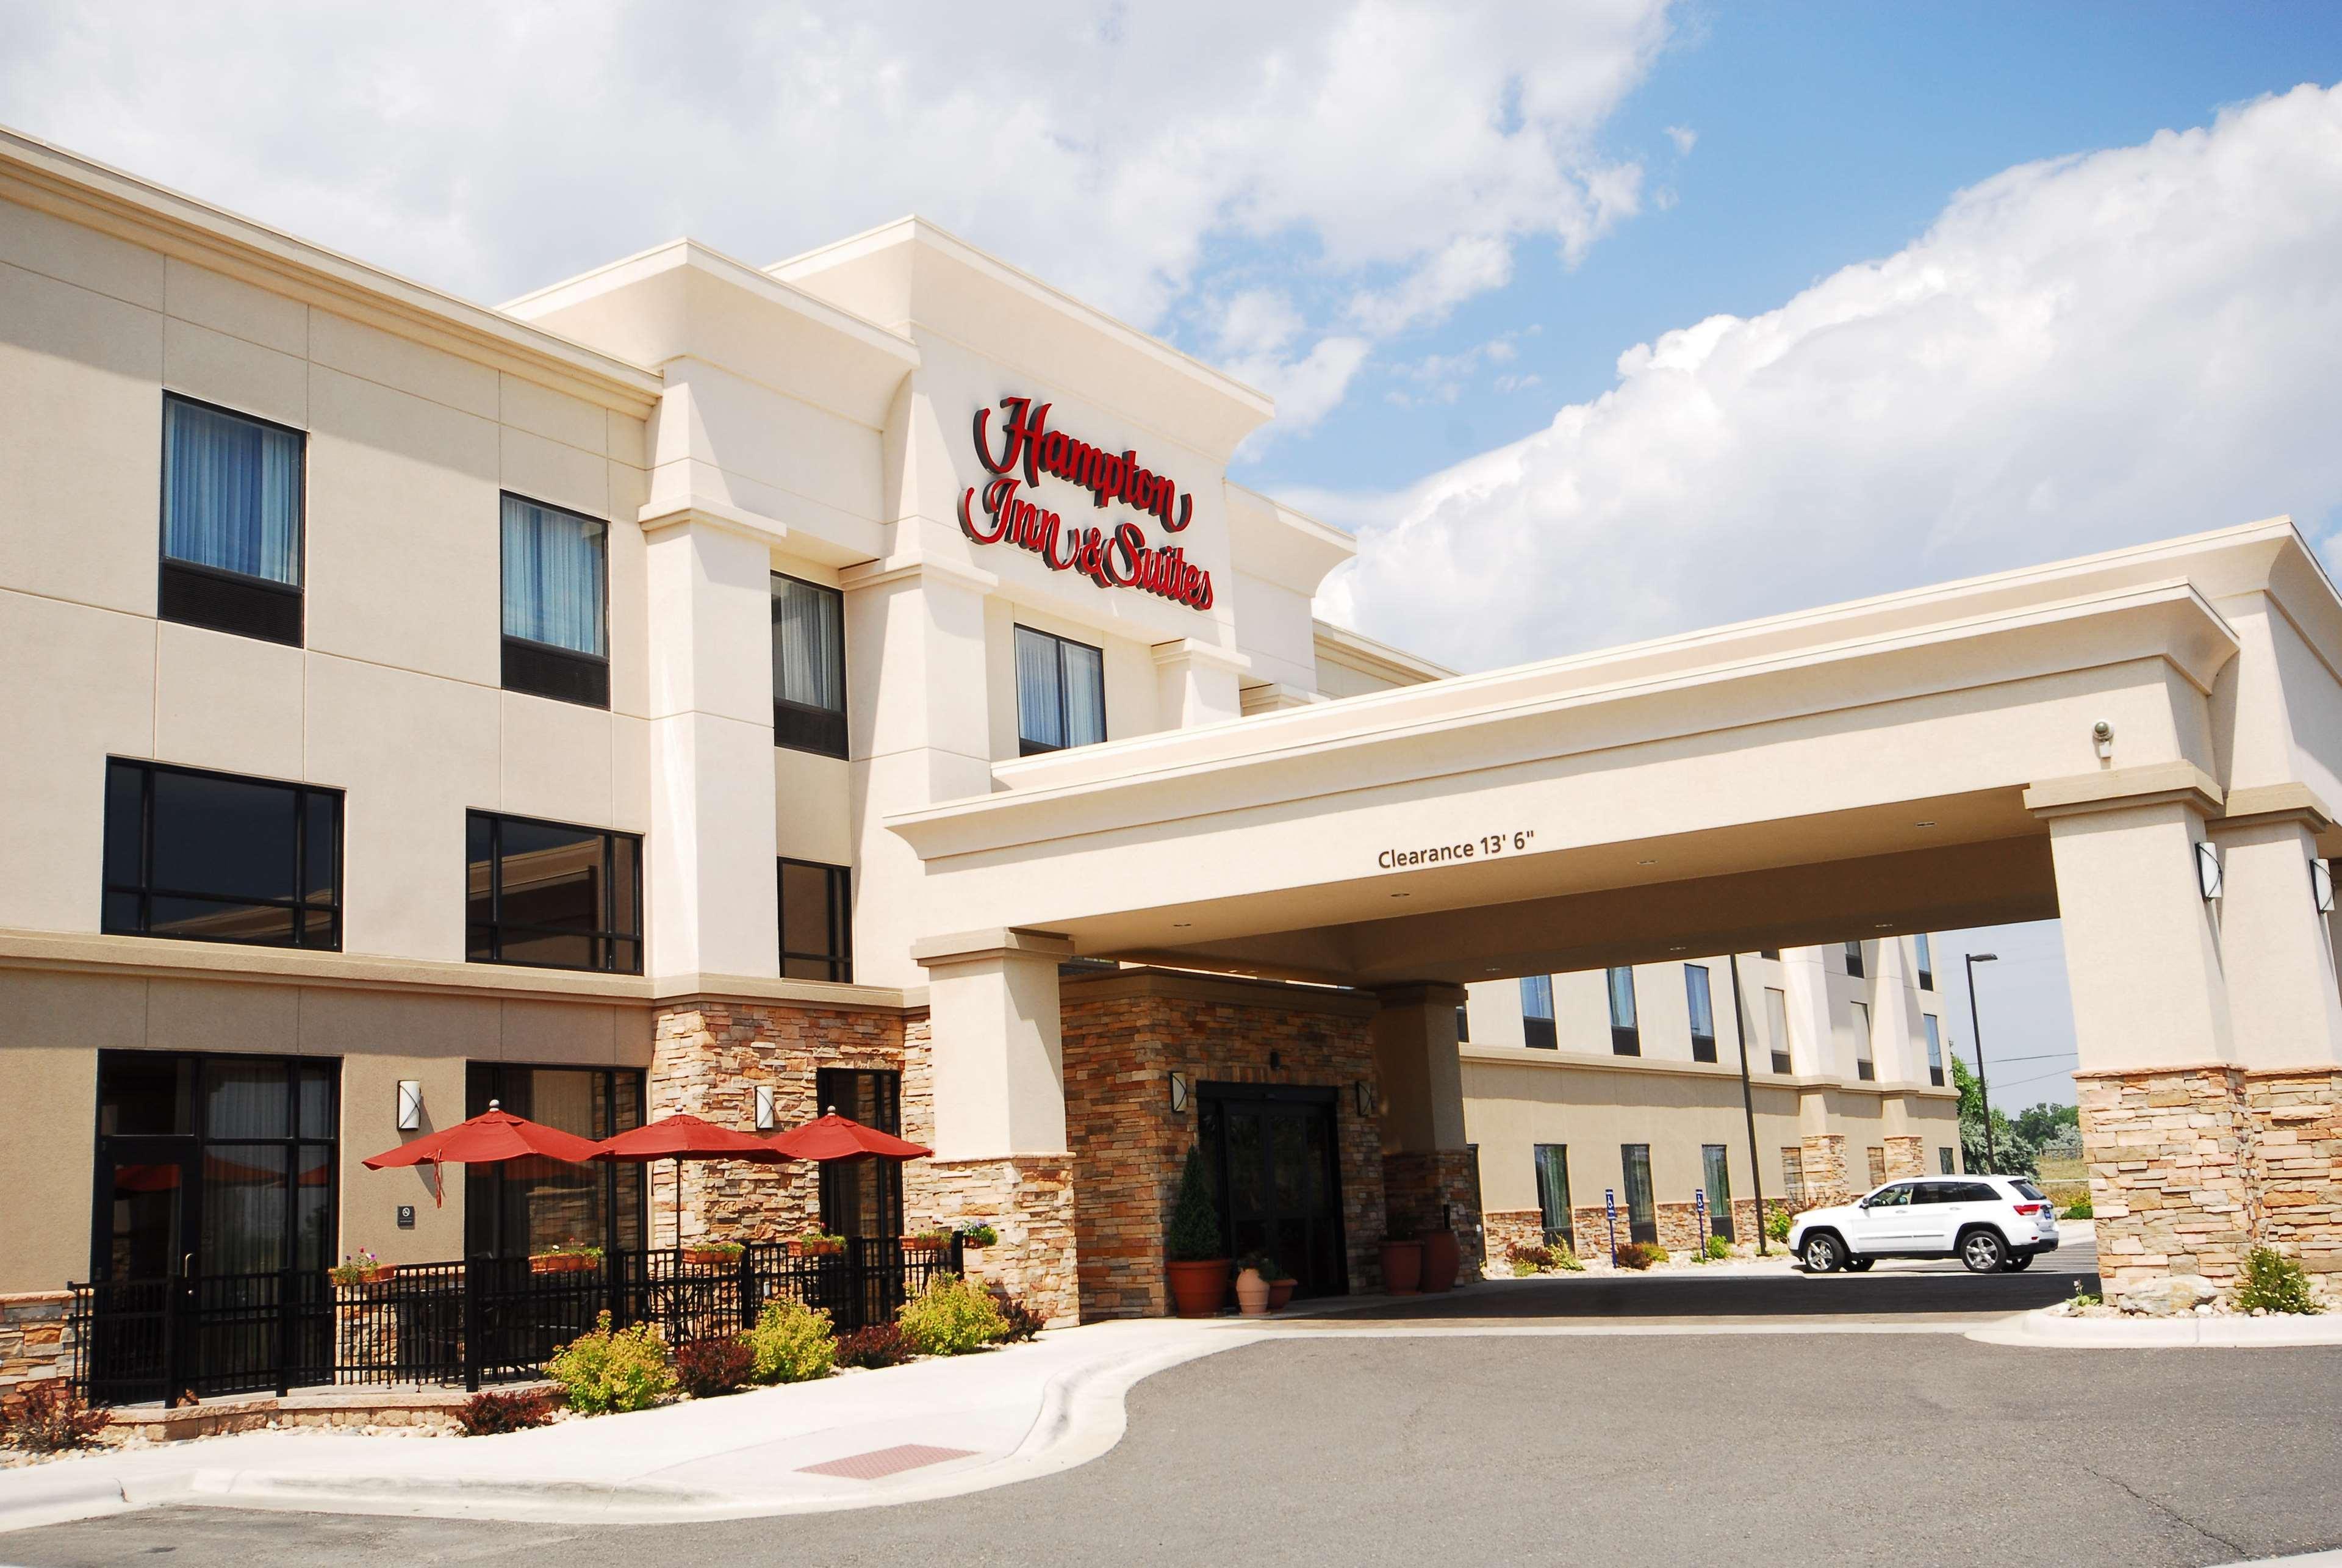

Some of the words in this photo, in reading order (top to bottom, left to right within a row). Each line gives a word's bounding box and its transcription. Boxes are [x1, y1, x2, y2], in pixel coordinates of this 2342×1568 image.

[973, 397, 1192, 533] Hampton
[957, 478, 1080, 571] Inn
[1075, 527, 1112, 589] &
[1102, 522, 1213, 611] Suites
[1378, 843, 1474, 869] Clearance
[1481, 835, 1506, 854] 13'
[1514, 830, 1534, 850] 6"
